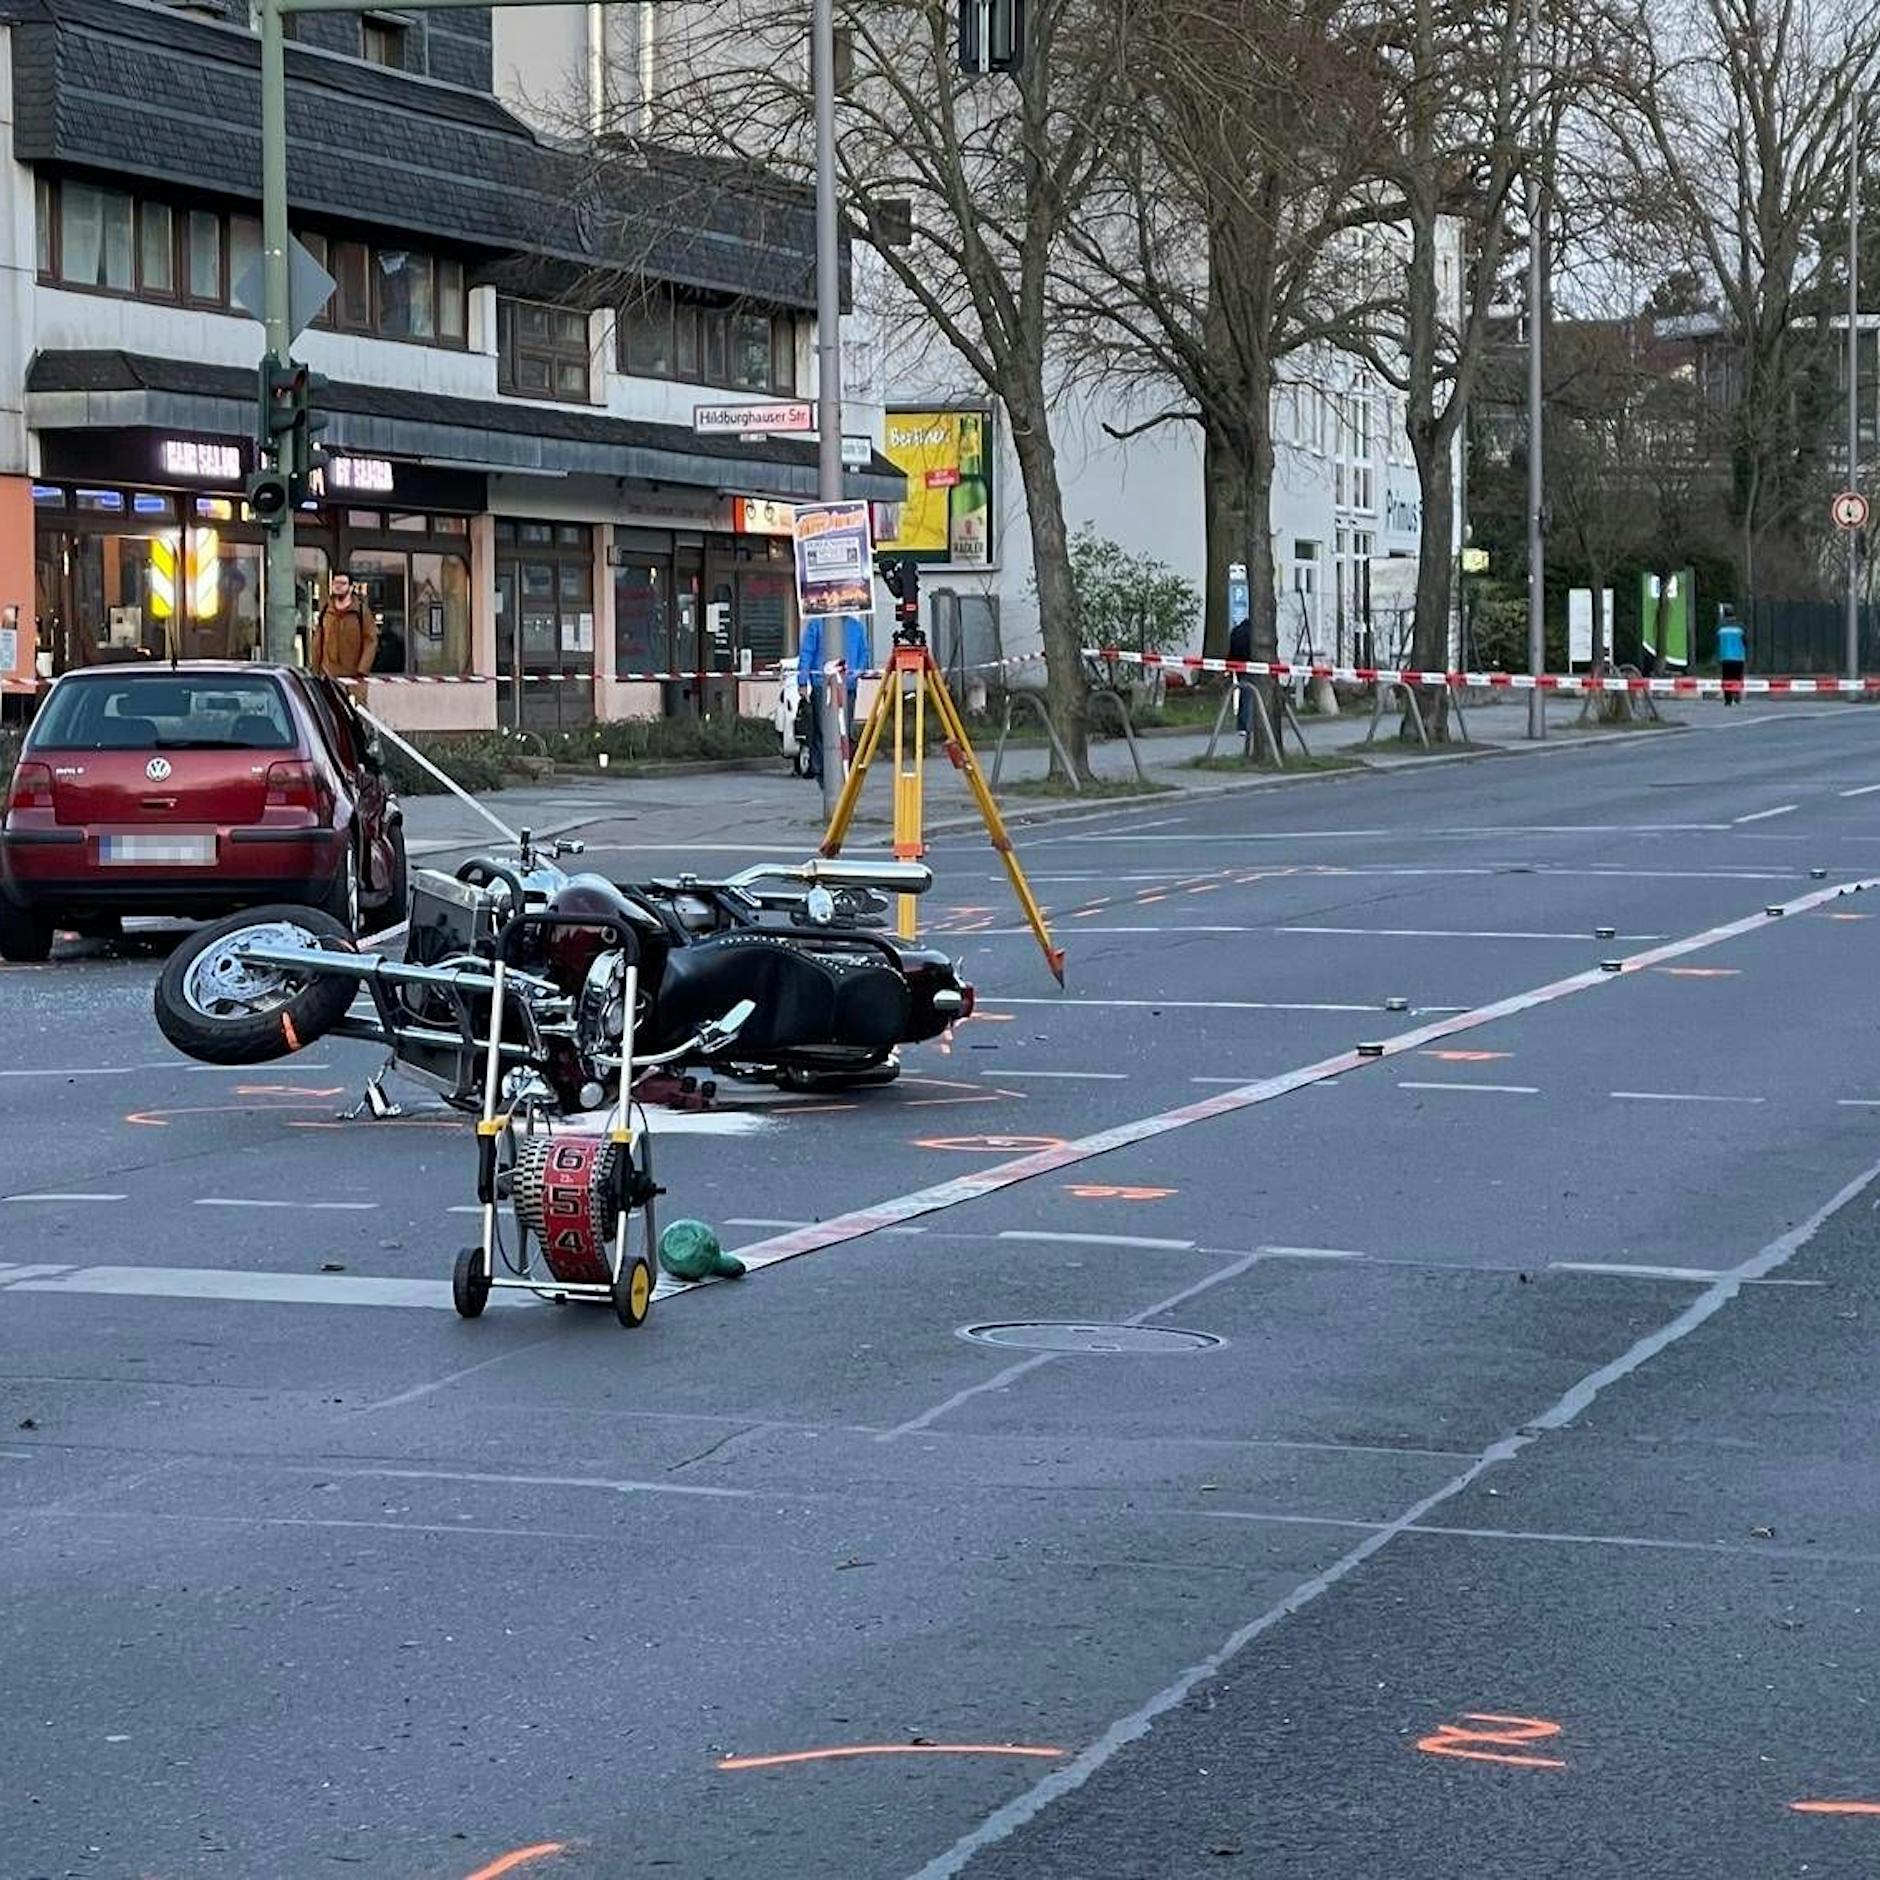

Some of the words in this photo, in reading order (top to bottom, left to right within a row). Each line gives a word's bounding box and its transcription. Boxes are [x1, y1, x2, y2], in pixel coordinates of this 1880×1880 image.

[699, 410, 786, 426] Hildburghauser
[553, 1146, 589, 1172] 6
[549, 1185, 582, 1218] 5
[555, 1228, 586, 1254] 4
